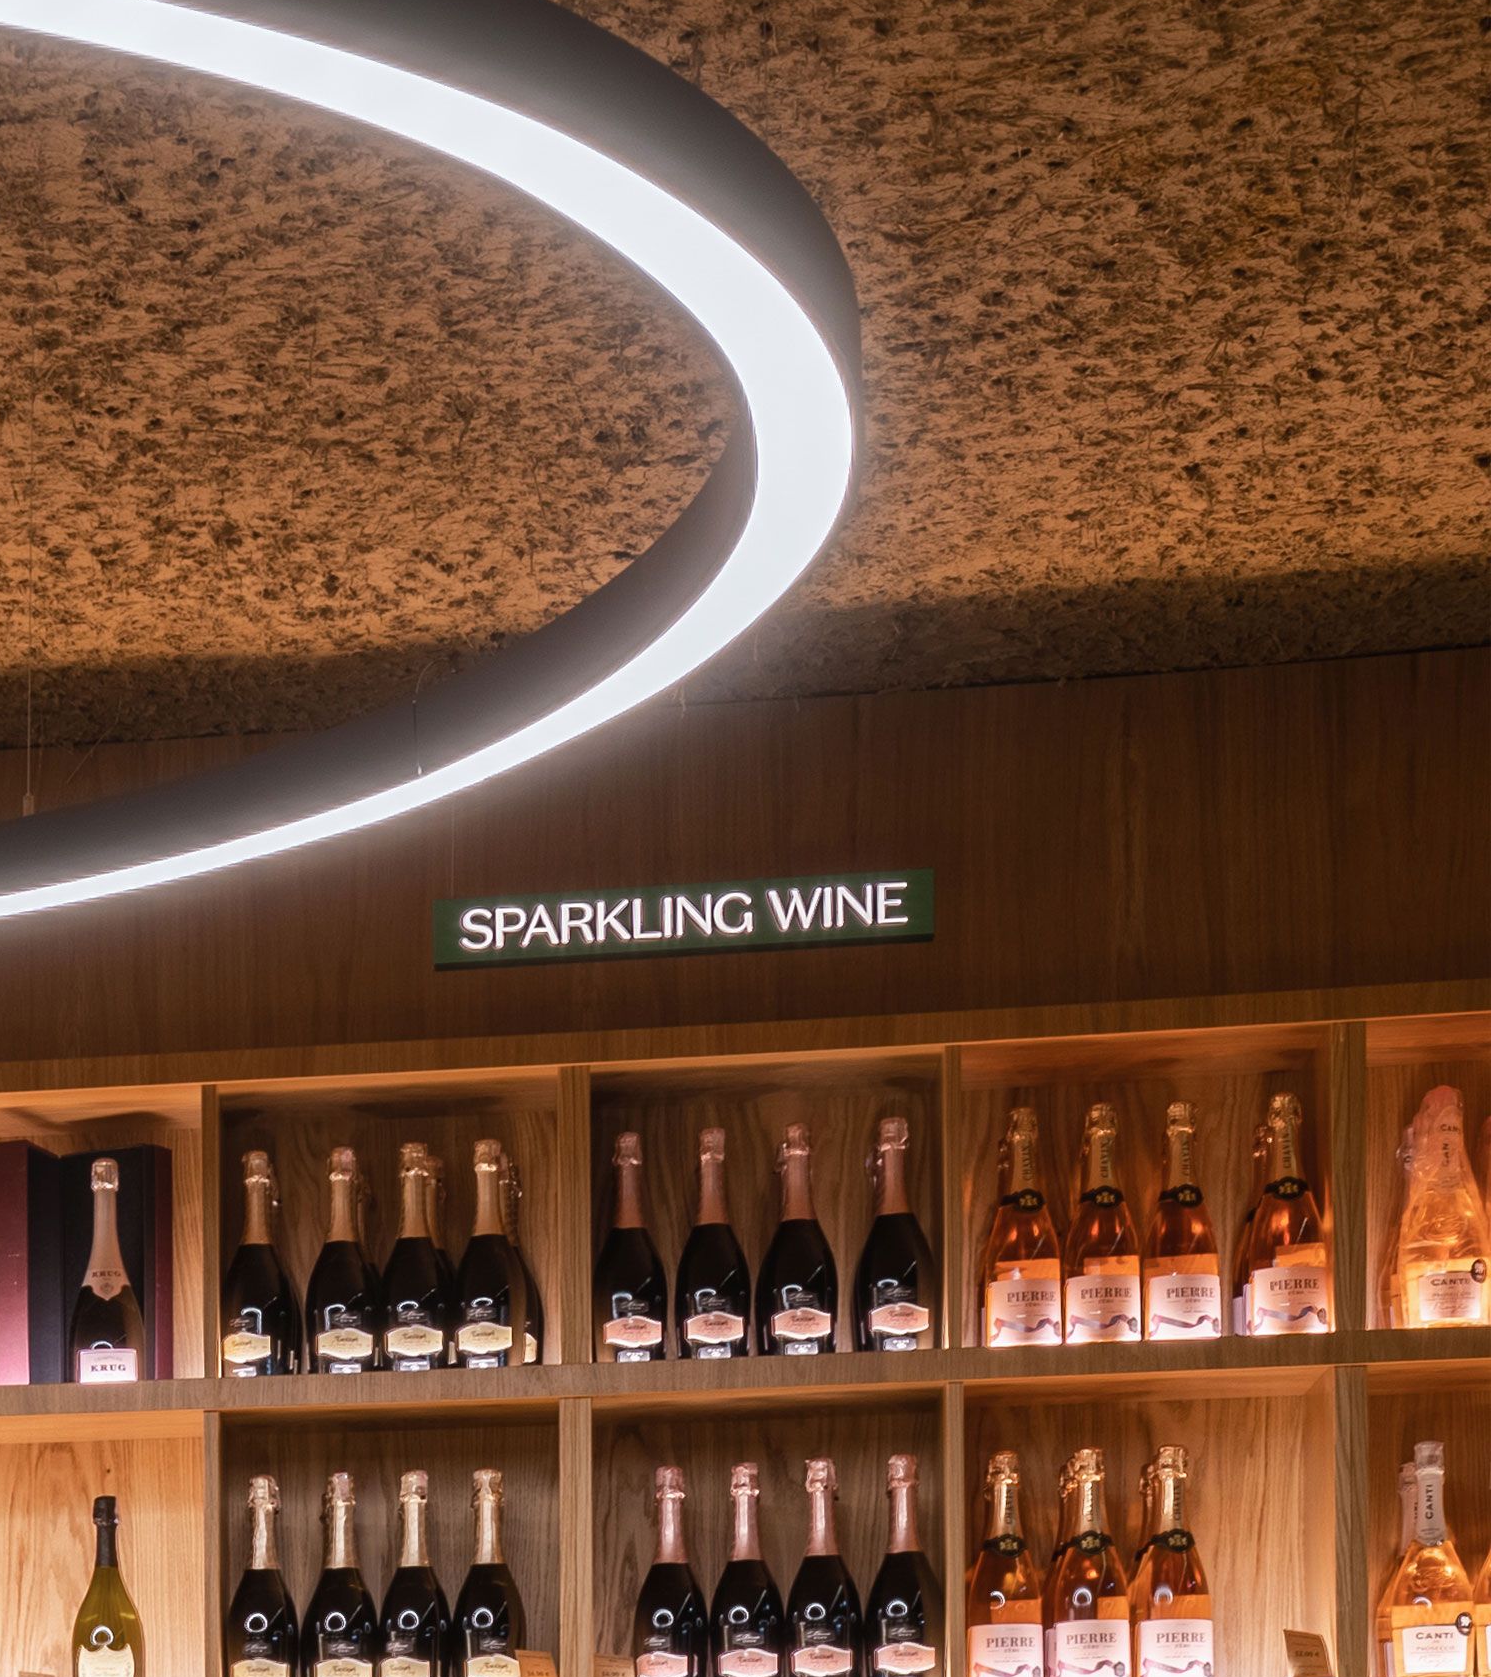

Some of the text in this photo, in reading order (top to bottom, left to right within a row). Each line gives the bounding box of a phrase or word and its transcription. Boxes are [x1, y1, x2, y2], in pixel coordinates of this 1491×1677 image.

[459, 881, 908, 951] SPARKLING WINE
[92, 1270, 121, 1278] KRUG
[1269, 1278, 1319, 1292] PIERRE
[1006, 1290, 1057, 1303] PIERRE
[1080, 1287, 1132, 1300] PIERRE
[1166, 1286, 1216, 1299] PIERRE
[90, 1363, 127, 1372] KRUG
[1425, 1484, 1434, 1519] CANTI
[1066, 1632, 1118, 1645] PIERRE
[1156, 1632, 1207, 1644] PIERRE
[1416, 1631, 1454, 1640] CANTI
[986, 1636, 1036, 1649] PIERRE
